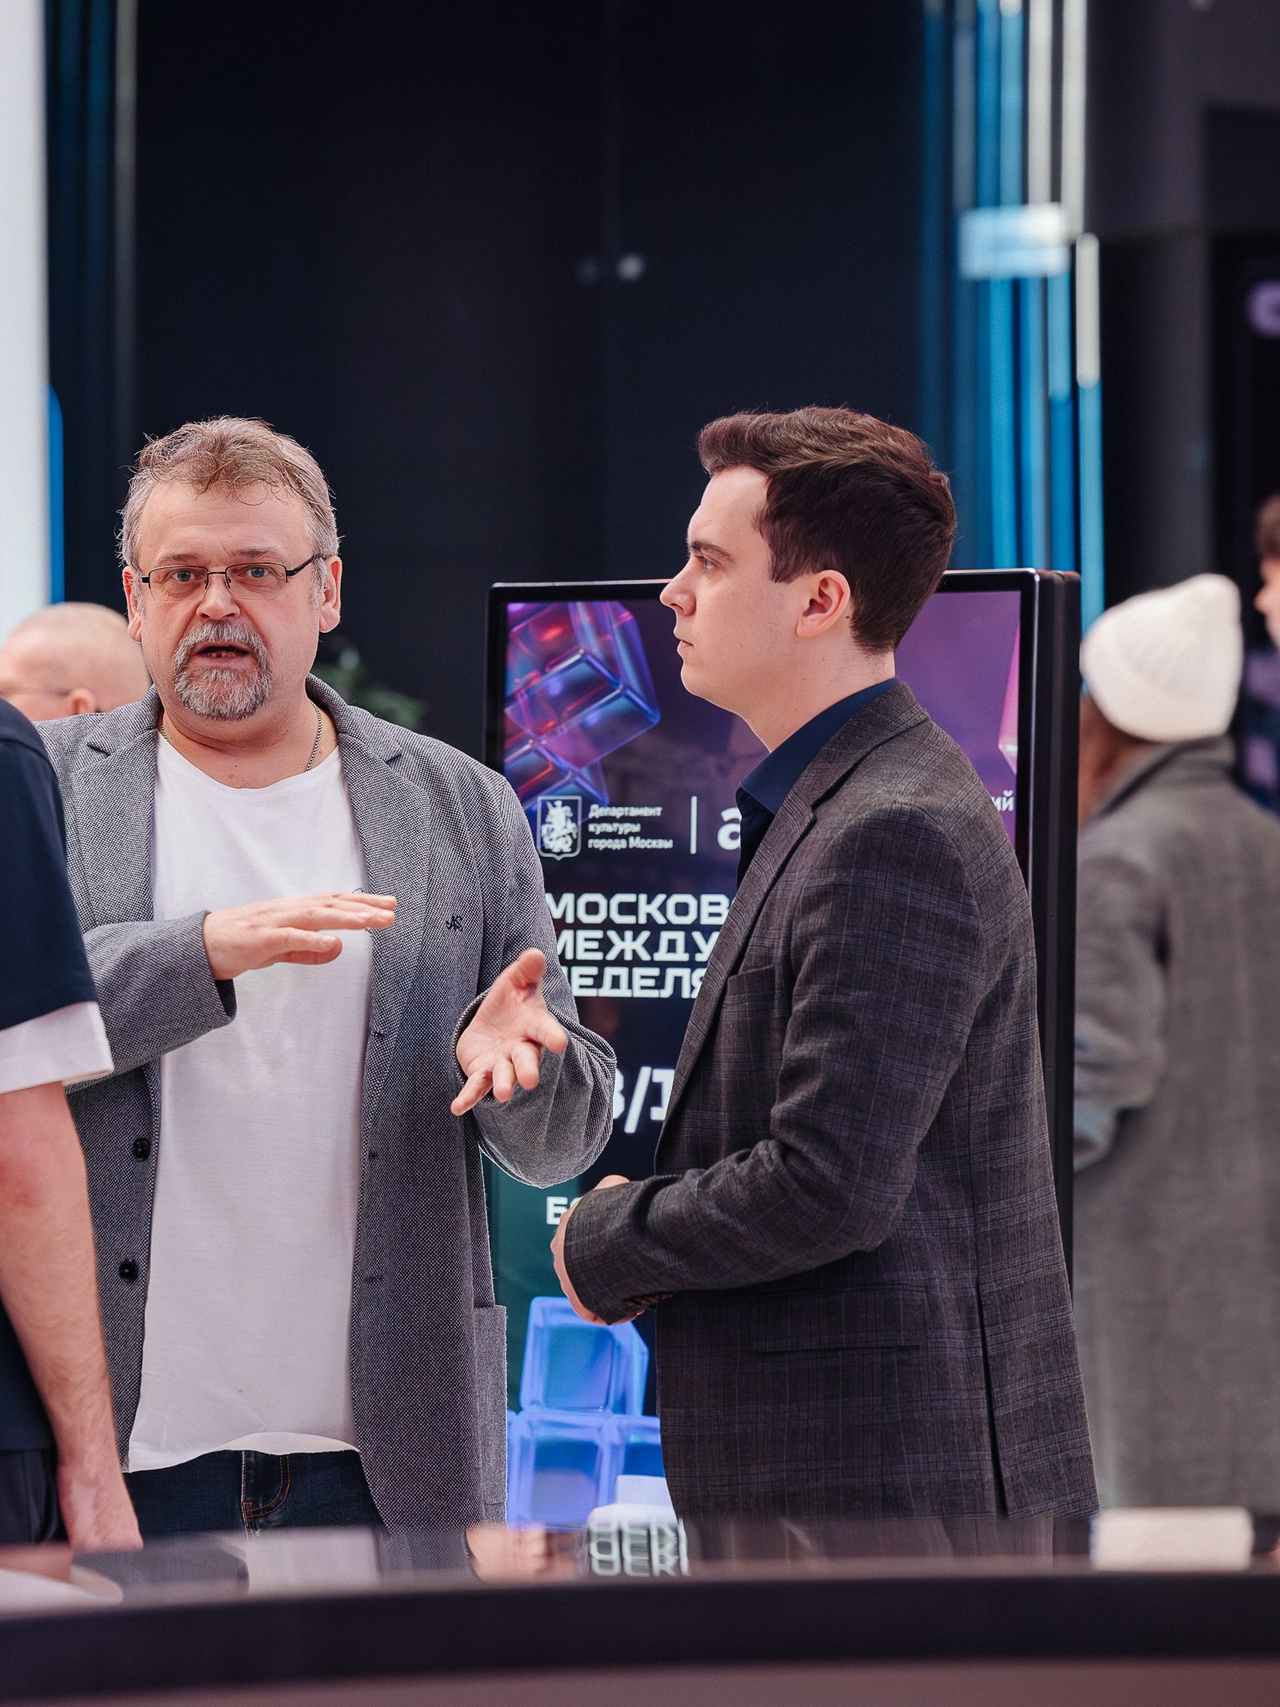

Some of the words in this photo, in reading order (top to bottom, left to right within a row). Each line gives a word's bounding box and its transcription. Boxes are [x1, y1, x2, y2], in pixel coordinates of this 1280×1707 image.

[588, 804, 663, 818] Департамент
[588, 822, 641, 835] культуры
[588, 838, 627, 850] города
[628, 836, 674, 849] Москвы
[545, 892, 736, 925] МОСКОВ
[562, 966, 707, 998] ЕДЕЛ
